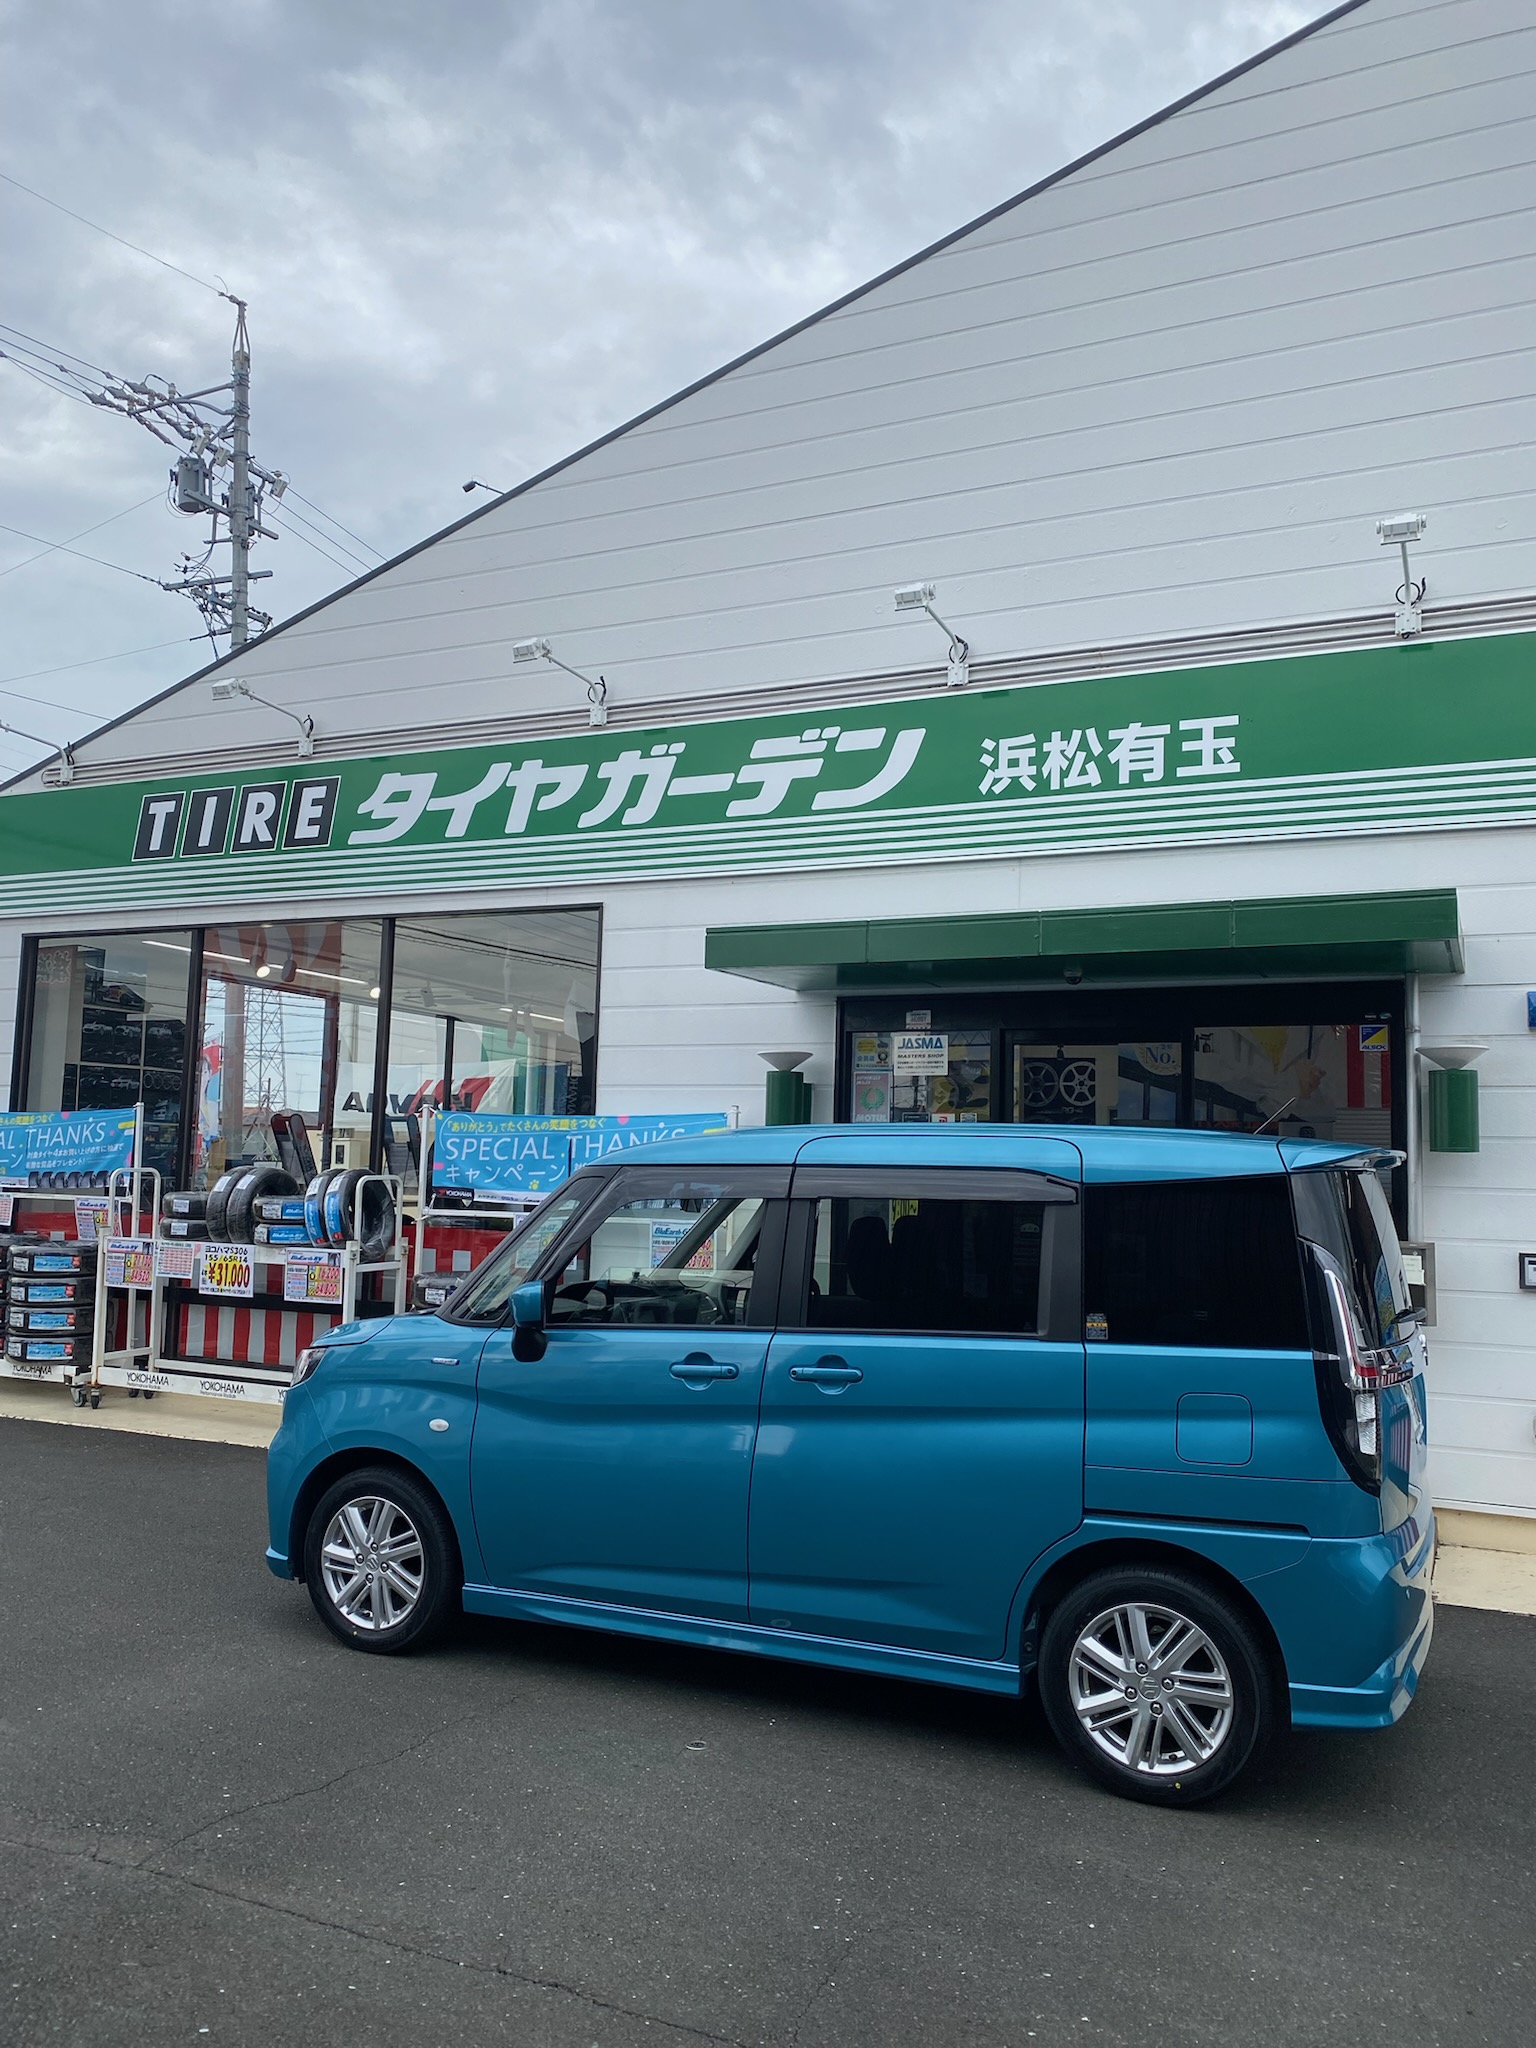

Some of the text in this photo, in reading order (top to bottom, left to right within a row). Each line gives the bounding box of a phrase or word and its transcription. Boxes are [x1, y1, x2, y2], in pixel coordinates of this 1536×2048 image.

[147, 714, 1241, 851] TIRE タイヤガーデン 浜松有玉
[898, 1037, 943, 1049] JASMA
[1144, 1046, 1176, 1064] No.
[25, 1122, 106, 1149] THANKS
[445, 1137, 555, 1160] SPECIAL
[446, 1163, 565, 1184] キャンペーン
[127, 1372, 169, 1386] YOKOHAMA
[200, 1380, 245, 1395] YOKOHAMA
